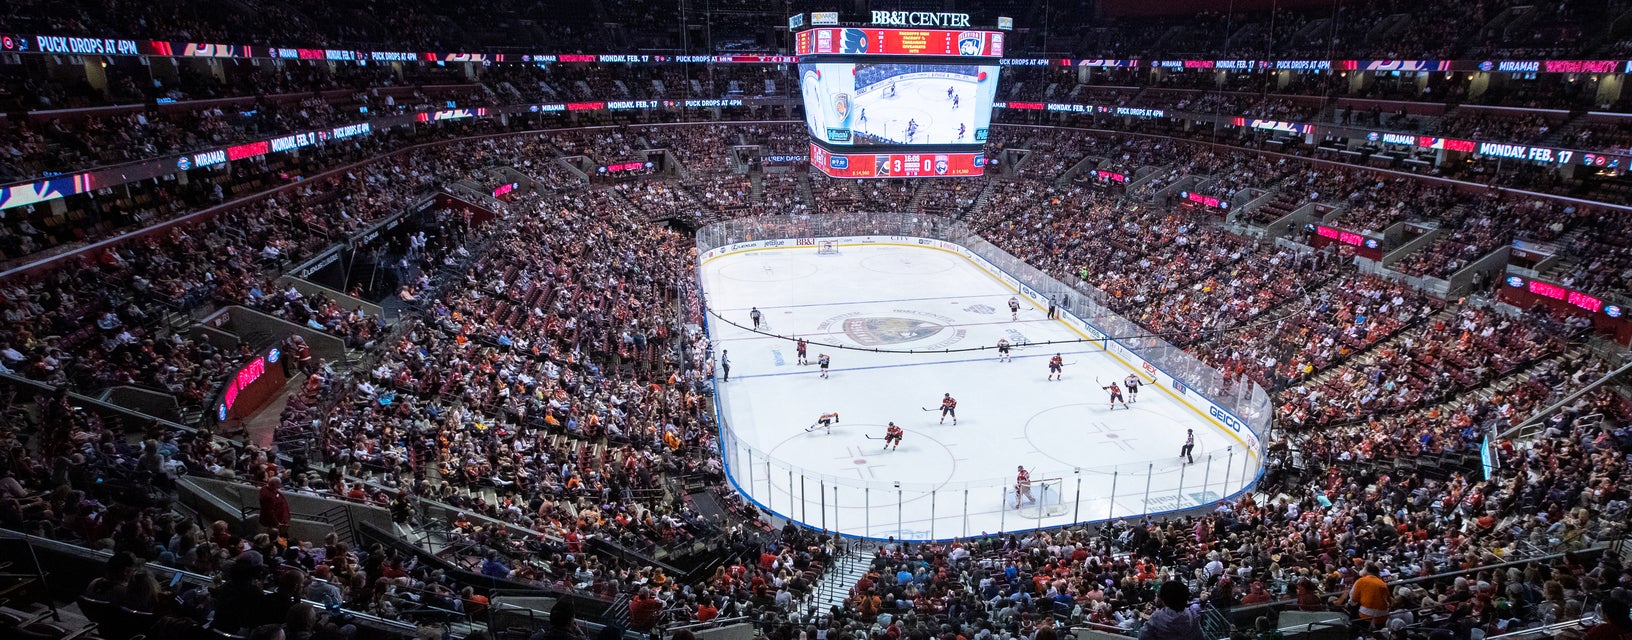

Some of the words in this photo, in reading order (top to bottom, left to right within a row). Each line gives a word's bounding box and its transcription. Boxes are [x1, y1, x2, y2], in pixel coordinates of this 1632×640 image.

[872, 10, 909, 25] BB&T
[910, 12, 970, 26] CENTER
[36, 36, 70, 52] PUCK
[68, 37, 104, 54] DROPS
[104, 39, 117, 54] AT
[117, 40, 138, 55] 4PM
[371, 51, 385, 60] PUCK
[386, 52, 400, 61] DROPS
[1276, 60, 1290, 68] PUCK
[1290, 60, 1308, 68] DROPS
[1317, 61, 1331, 69] 4PM
[1498, 61, 1540, 71] MIRAMAR
[1582, 60, 1620, 72] PARTY
[1130, 108, 1146, 116] DROPS
[333, 126, 344, 139] PUCK
[194, 150, 226, 167] MIRAMAR
[308, 131, 315, 144] 17
[1382, 134, 1415, 145] MIRAMAR
[1528, 147, 1554, 162] FEB.
[1558, 150, 1573, 164] 17
[893, 160, 901, 172] 3
[924, 159, 931, 172] 0
[764, 239, 785, 248] jetBlue
[1142, 361, 1157, 376] DEX
[1210, 405, 1240, 433] GEICO
